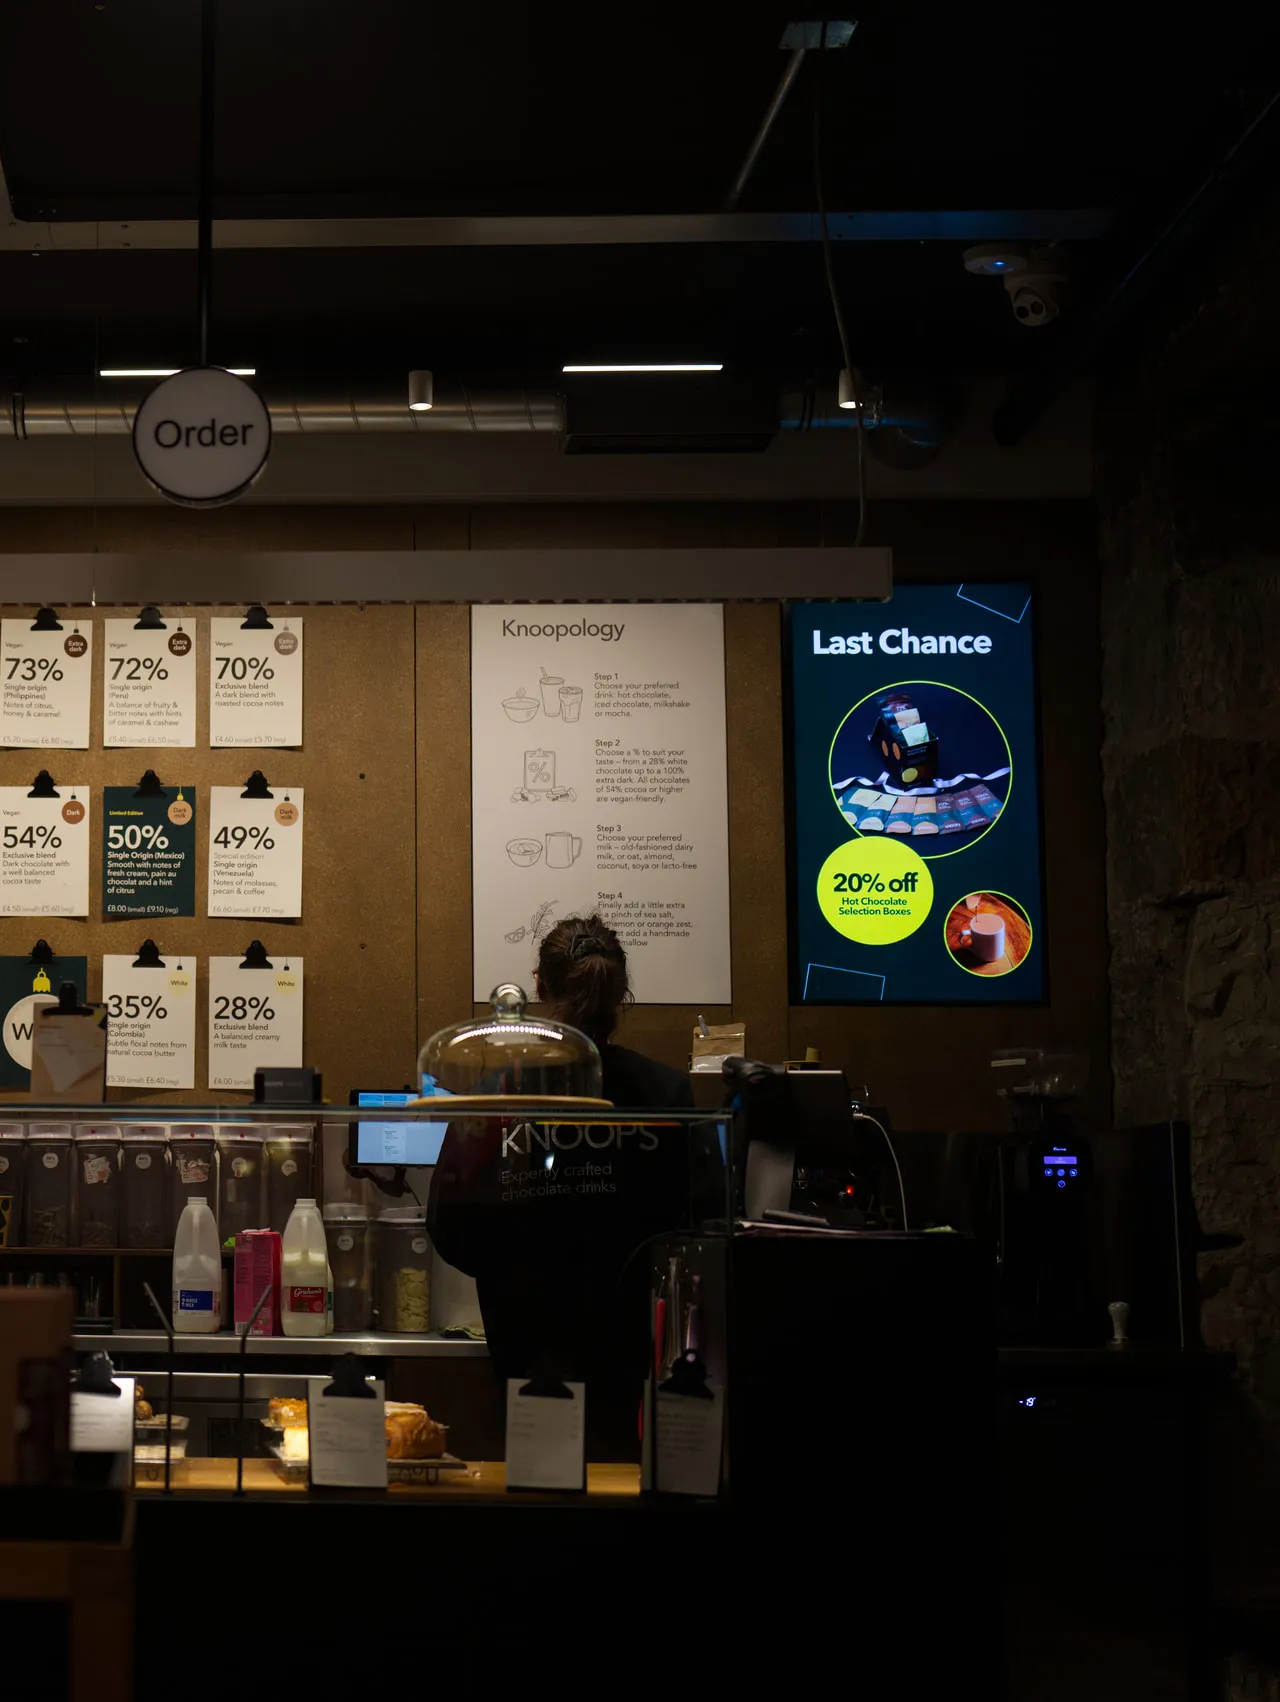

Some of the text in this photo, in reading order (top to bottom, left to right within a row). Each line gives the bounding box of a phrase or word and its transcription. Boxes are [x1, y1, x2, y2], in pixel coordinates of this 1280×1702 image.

[155, 418, 254, 448] Order
[503, 618, 625, 642] Knoopology
[813, 628, 992, 654] Last Chance
[5, 658, 64, 681] 73%
[110, 658, 168, 681] 72%
[215, 657, 275, 680] 70%
[594, 673, 611, 681] Step
[4, 684, 25, 692] Single
[645, 682, 680, 690] preferred
[596, 740, 612, 748] Step
[3, 826, 62, 849] 54%
[108, 825, 169, 849] 50%
[214, 826, 275, 849] 49%
[597, 825, 614, 833] Step
[108, 852, 130, 860] Single
[131, 852, 153, 860] Origin
[214, 861, 236, 869] Single
[833, 872, 918, 893] 20% off
[598, 892, 615, 900] Step
[842, 898, 907, 906] Hot Chocolate
[165, 907, 178, 915] (reg)
[839, 907, 911, 916] Selection Boxes
[108, 995, 167, 1019] 35%
[214, 997, 275, 1020] 28%
[502, 1122, 659, 1158] KNOOPS
[502, 1162, 612, 1184] Expertly crafted
[502, 1180, 617, 1202] chocolate drinks
